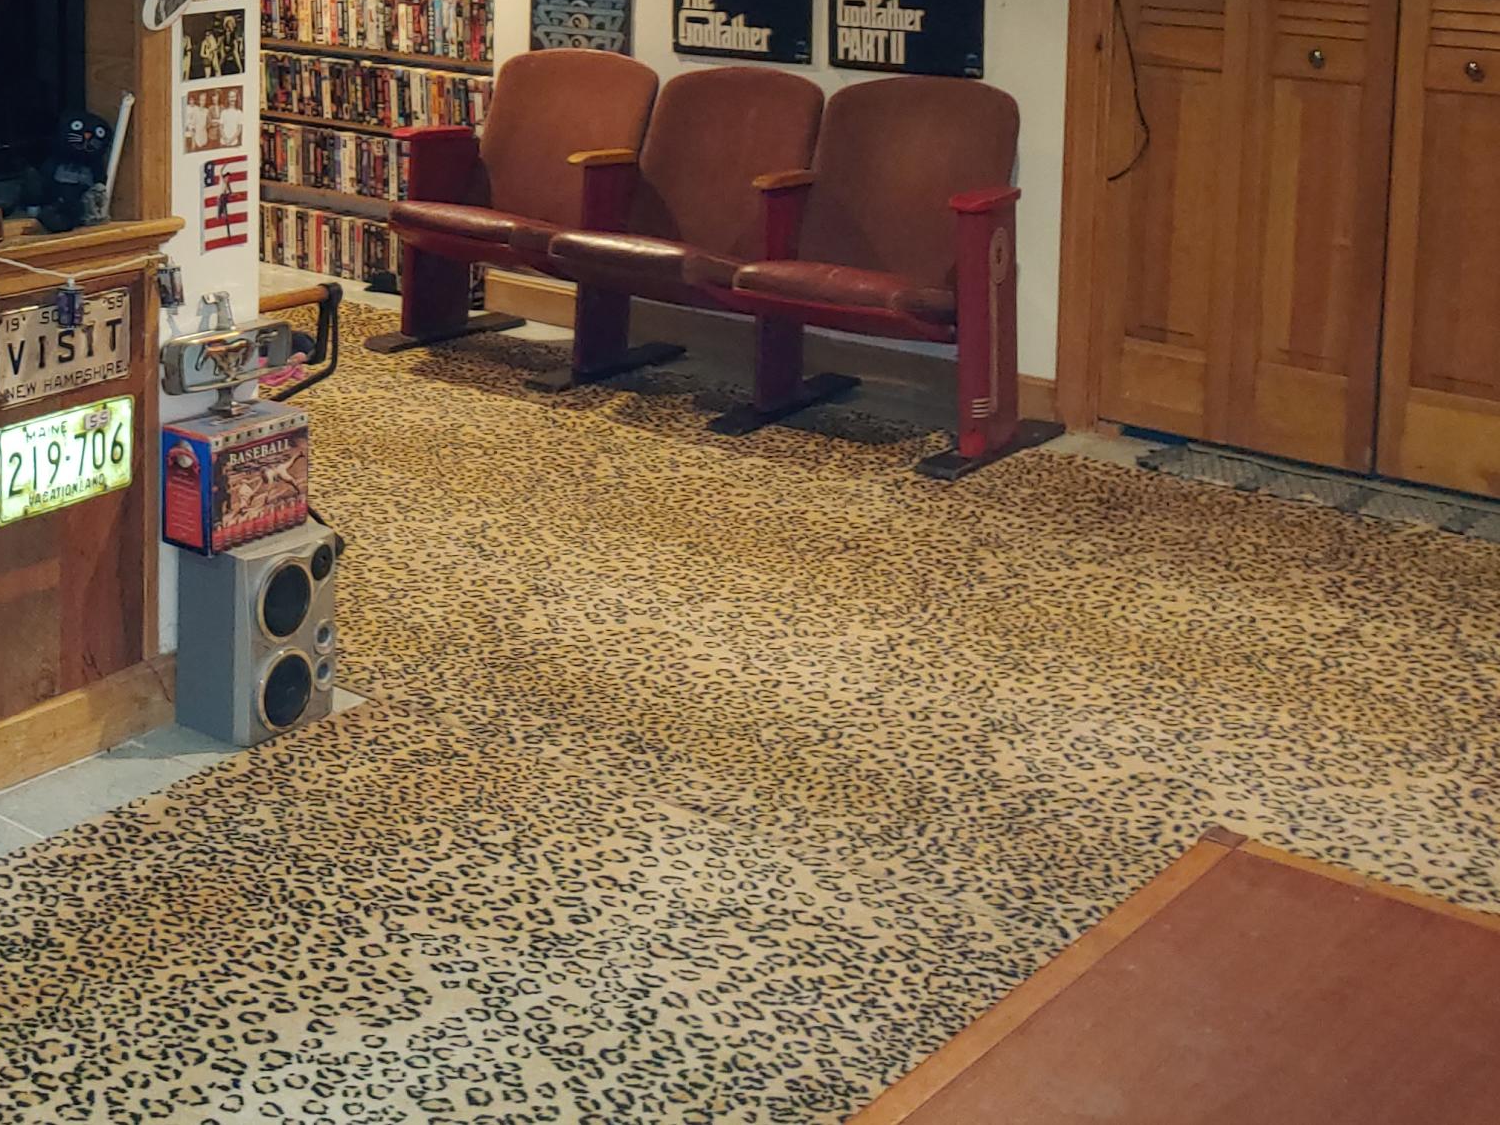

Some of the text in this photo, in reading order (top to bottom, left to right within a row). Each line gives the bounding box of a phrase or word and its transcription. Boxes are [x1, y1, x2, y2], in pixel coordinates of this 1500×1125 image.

[677, 8, 773, 53] Godfather
[837, 26, 907, 66] PART II
[6, 318, 123, 377] VISIT
[5, 360, 126, 402] NEW HAMPSHIRE
[24, 419, 68, 444] MAINE
[229, 439, 291, 465] BASEBALL
[27, 472, 106, 508] VACATIONLAND
